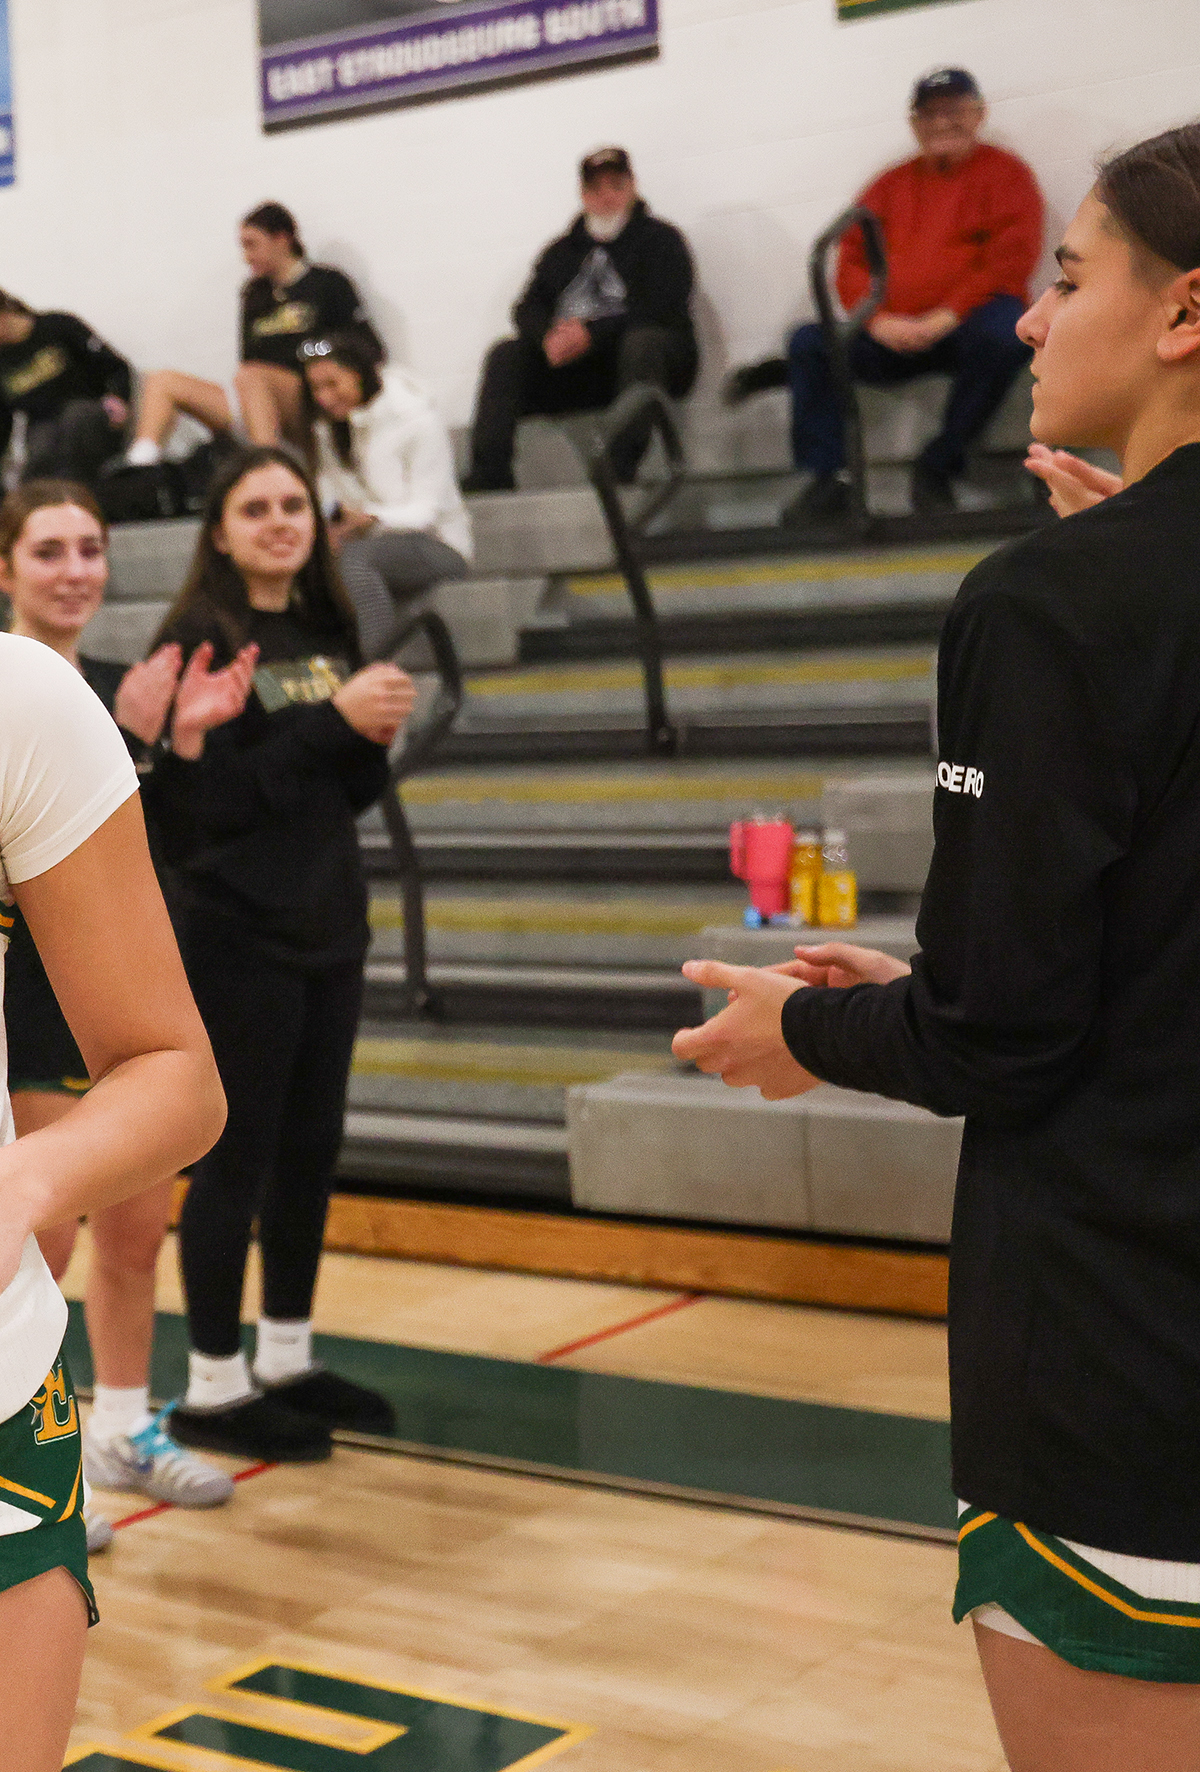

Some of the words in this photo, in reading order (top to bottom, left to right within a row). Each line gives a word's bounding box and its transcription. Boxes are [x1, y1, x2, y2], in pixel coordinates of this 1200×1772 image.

[266, 56, 334, 102] EAST
[543, 0, 648, 45] SOUTH
[936, 761, 985, 799] OERO
